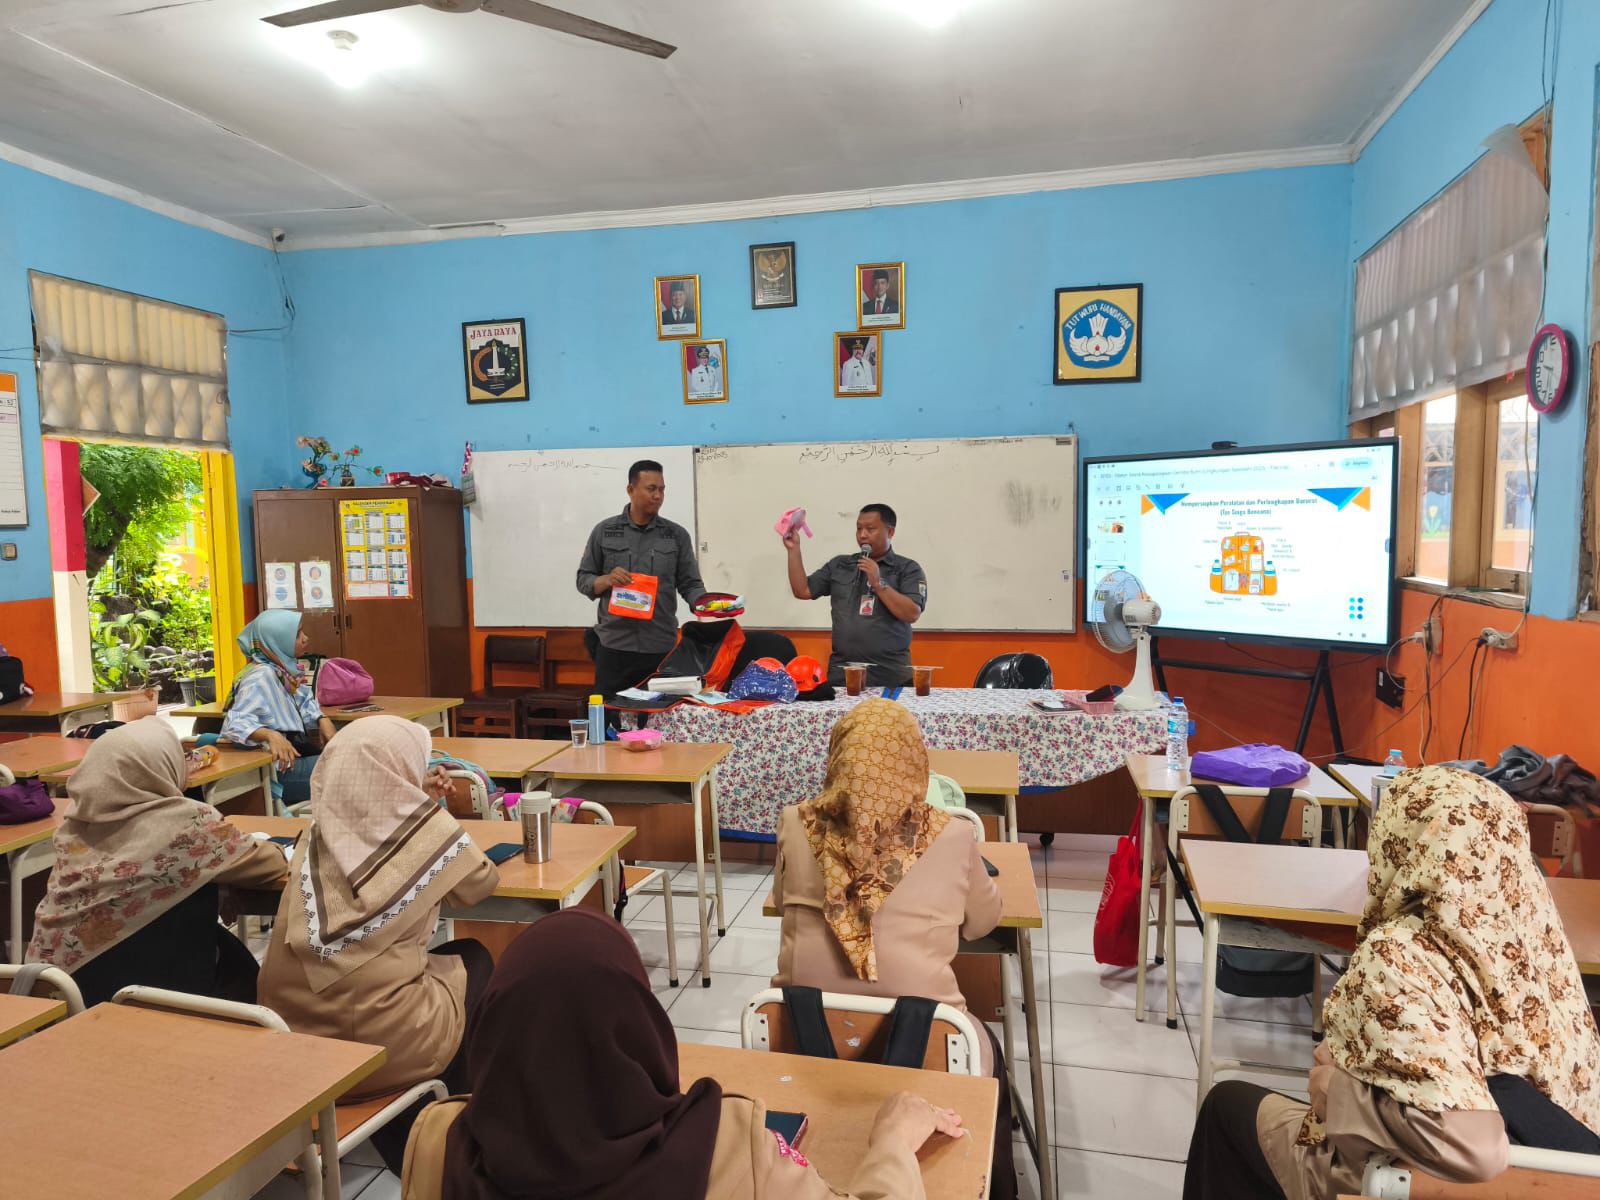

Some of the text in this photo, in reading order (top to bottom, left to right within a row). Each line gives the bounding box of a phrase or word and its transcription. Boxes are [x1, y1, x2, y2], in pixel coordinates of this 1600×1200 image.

[1064, 314, 1080, 330] TUT
[1078, 303, 1098, 318] WURI
[470, 326, 517, 339] JAYA RAYA
